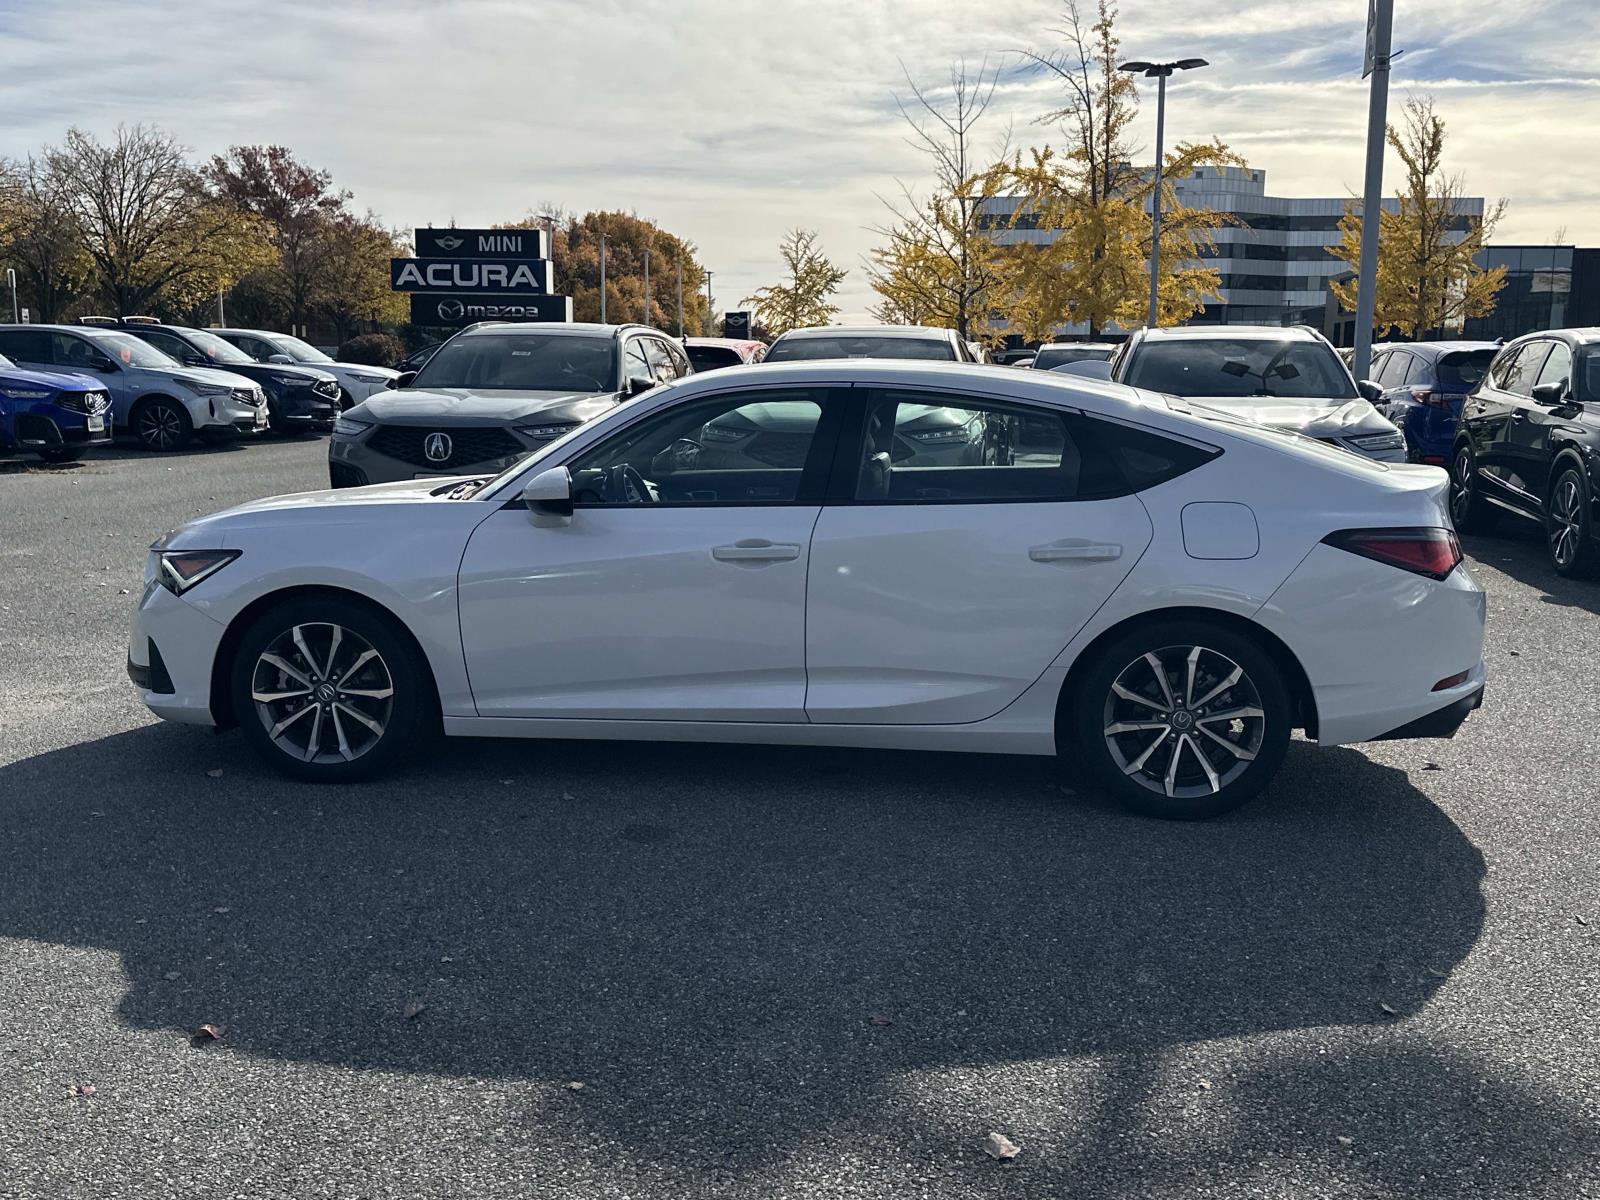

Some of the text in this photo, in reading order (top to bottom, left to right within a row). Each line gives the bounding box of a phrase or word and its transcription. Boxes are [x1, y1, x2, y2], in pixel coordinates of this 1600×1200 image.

[478, 235, 522, 252] MINI
[396, 263, 539, 287] ACURA
[467, 305, 539, 317] mazda
